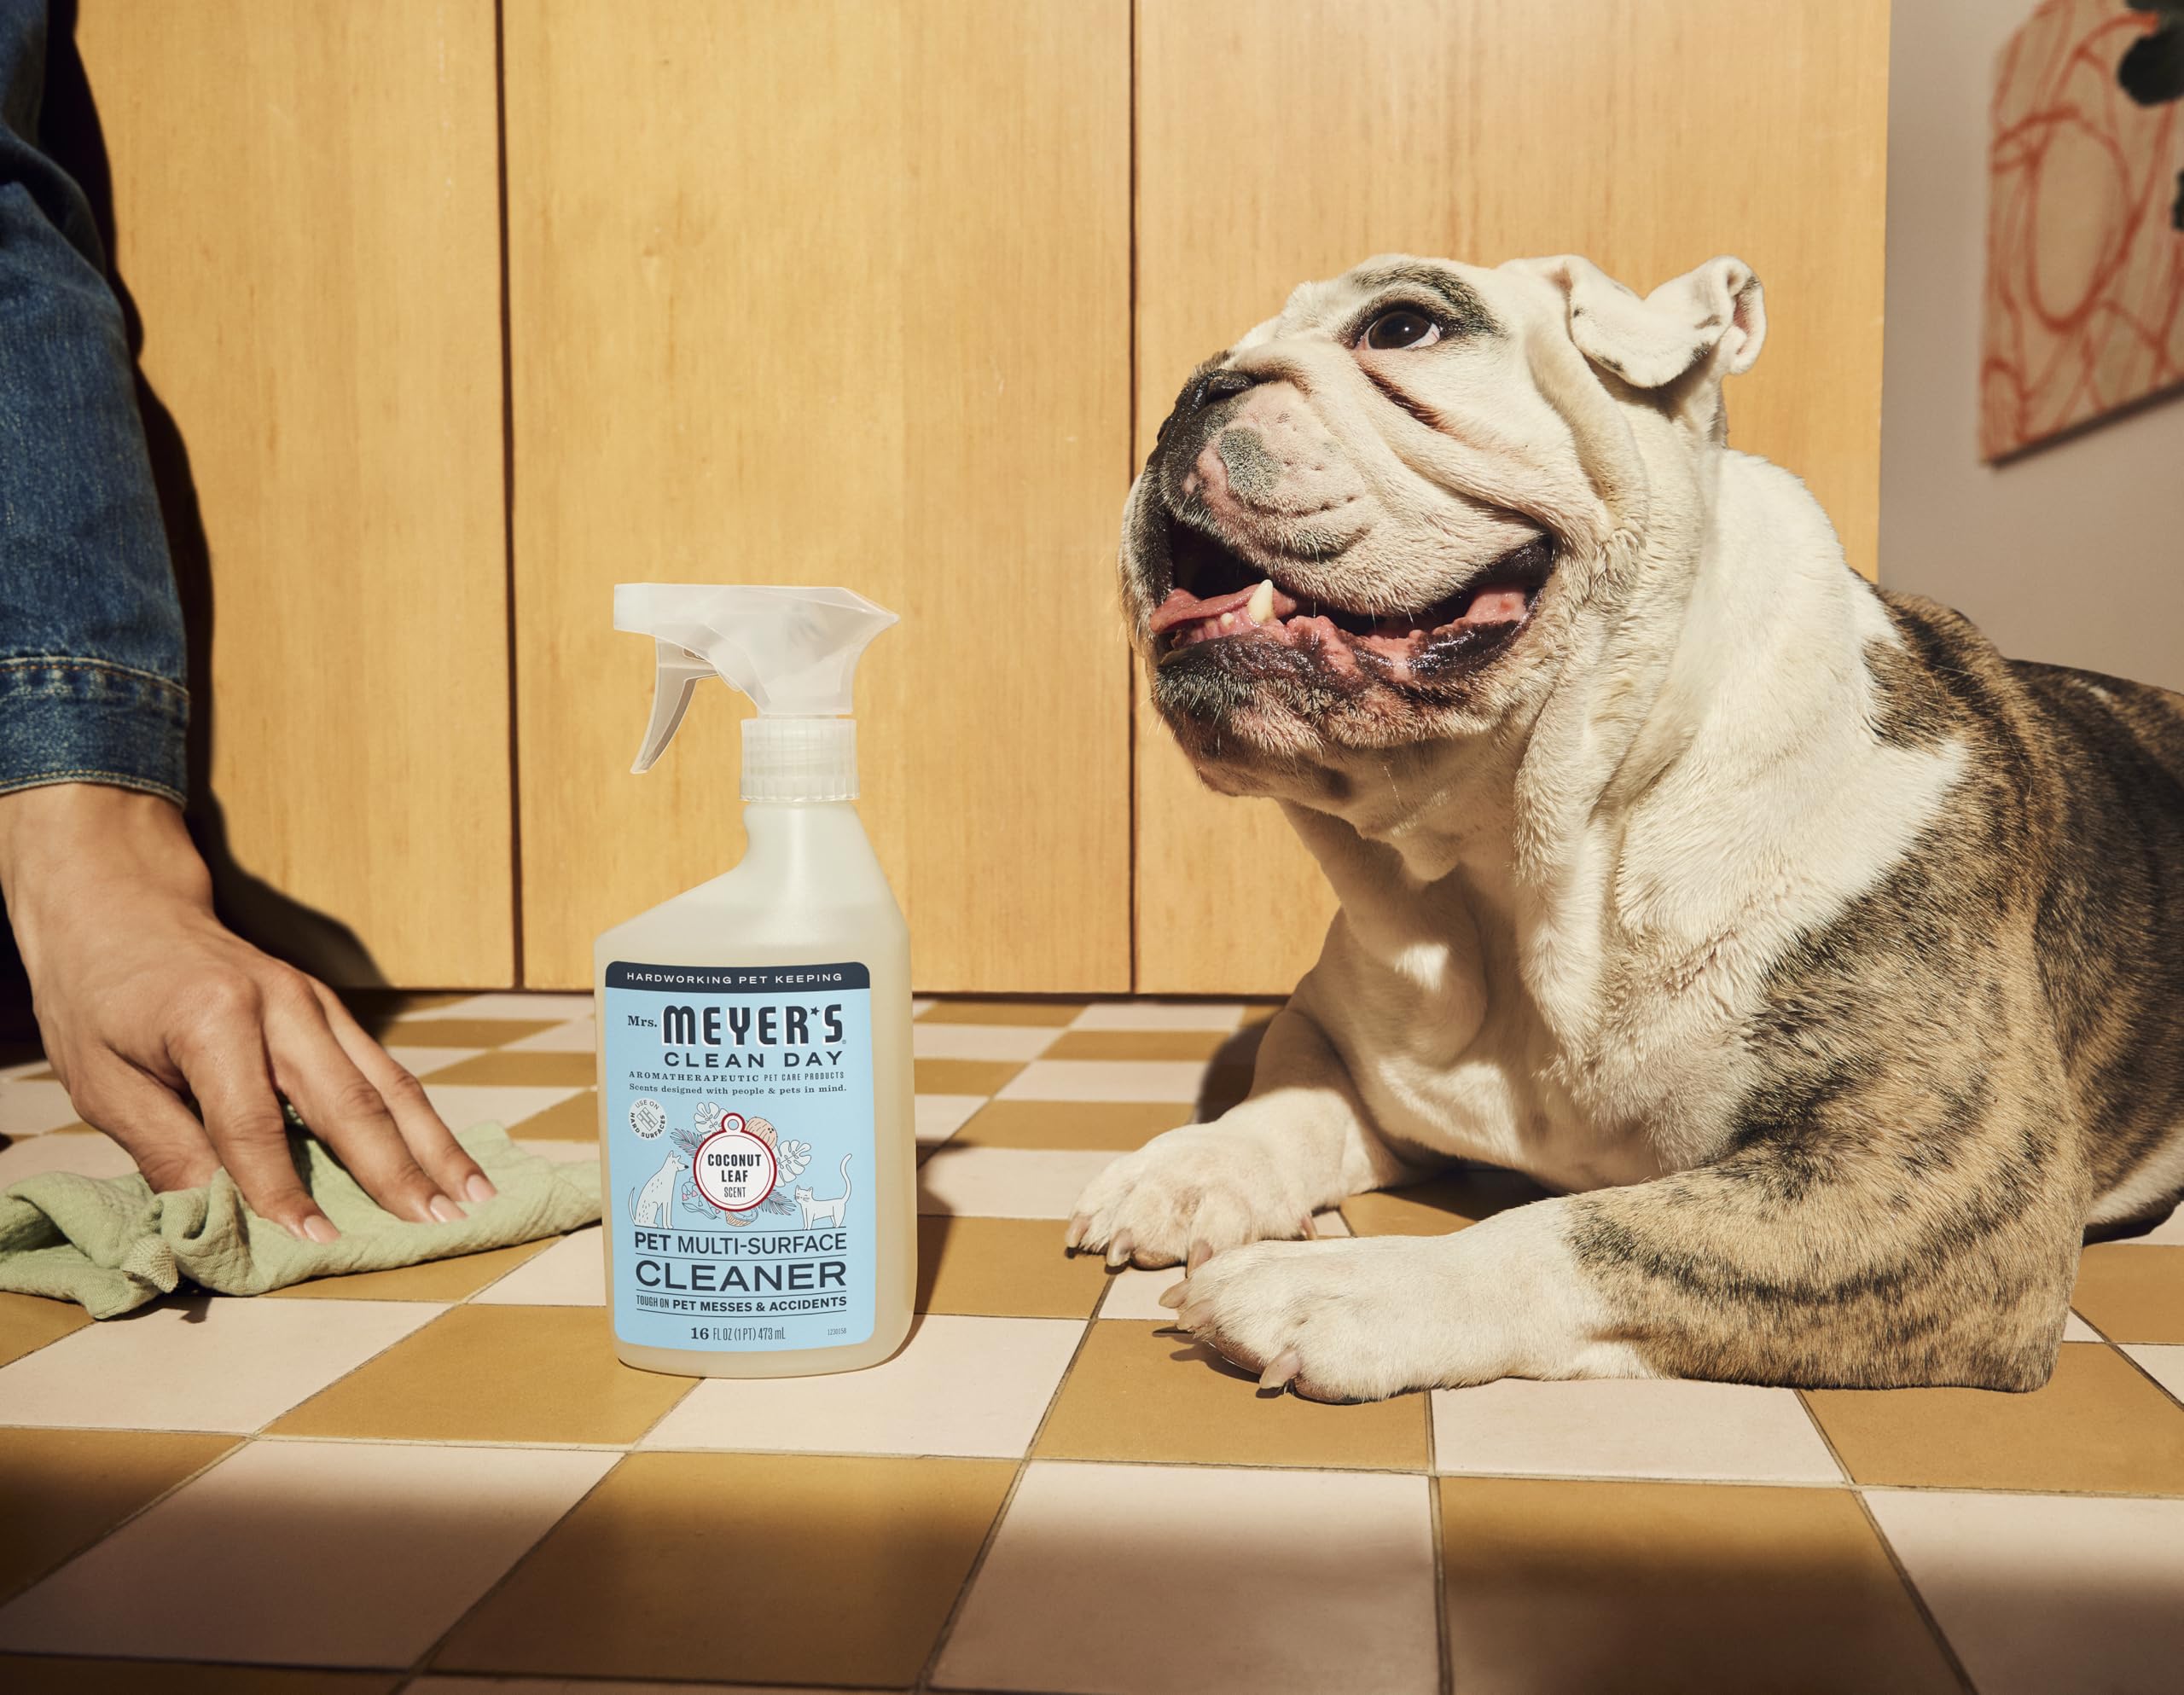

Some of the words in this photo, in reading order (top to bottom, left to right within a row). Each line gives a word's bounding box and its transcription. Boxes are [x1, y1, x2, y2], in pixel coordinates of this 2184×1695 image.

[627, 972, 732, 984] HARDWORKING
[739, 976, 768, 984] PET
[775, 972, 843, 984] KEEPING
[628, 1015, 658, 1028] Mrs.
[664, 1052, 764, 1068] CLEAN
[784, 1050, 843, 1067] DAY
[629, 1071, 759, 1082] AROMATHERAPEUTIC
[804, 1071, 845, 1080] PRODUCTS
[629, 1083, 659, 1092] Scents
[661, 1084, 702, 1095] designed
[732, 1087, 764, 1096] people
[780, 1087, 801, 1095] pets
[818, 1084, 847, 1093] mind.
[635, 1100, 648, 1109] USE
[649, 1100, 659, 1111] ON
[630, 1112, 641, 1134] HARD
[641, 1114, 665, 1139] SURFACES
[707, 1153, 762, 1167] COCONUT
[721, 1170, 749, 1183] LEAF
[723, 1187, 746, 1198] SCENT
[635, 1231, 671, 1251] PET
[677, 1233, 847, 1255] MULTI-SURFACE
[636, 1260, 846, 1292] CLEANER
[636, 1295, 659, 1307] TOUGH
[659, 1298, 669, 1308] ON
[673, 1299, 697, 1311] PET
[700, 1301, 752, 1312] MESSES
[755, 1302, 765, 1312] &
[769, 1296, 847, 1311] ACCIDENTS
[691, 1327, 709, 1340] 16
[713, 1328, 723, 1341] FL
[723, 1328, 732, 1341] OZ
[758, 1327, 773, 1340] 473
[775, 1327, 786, 1340] mL
